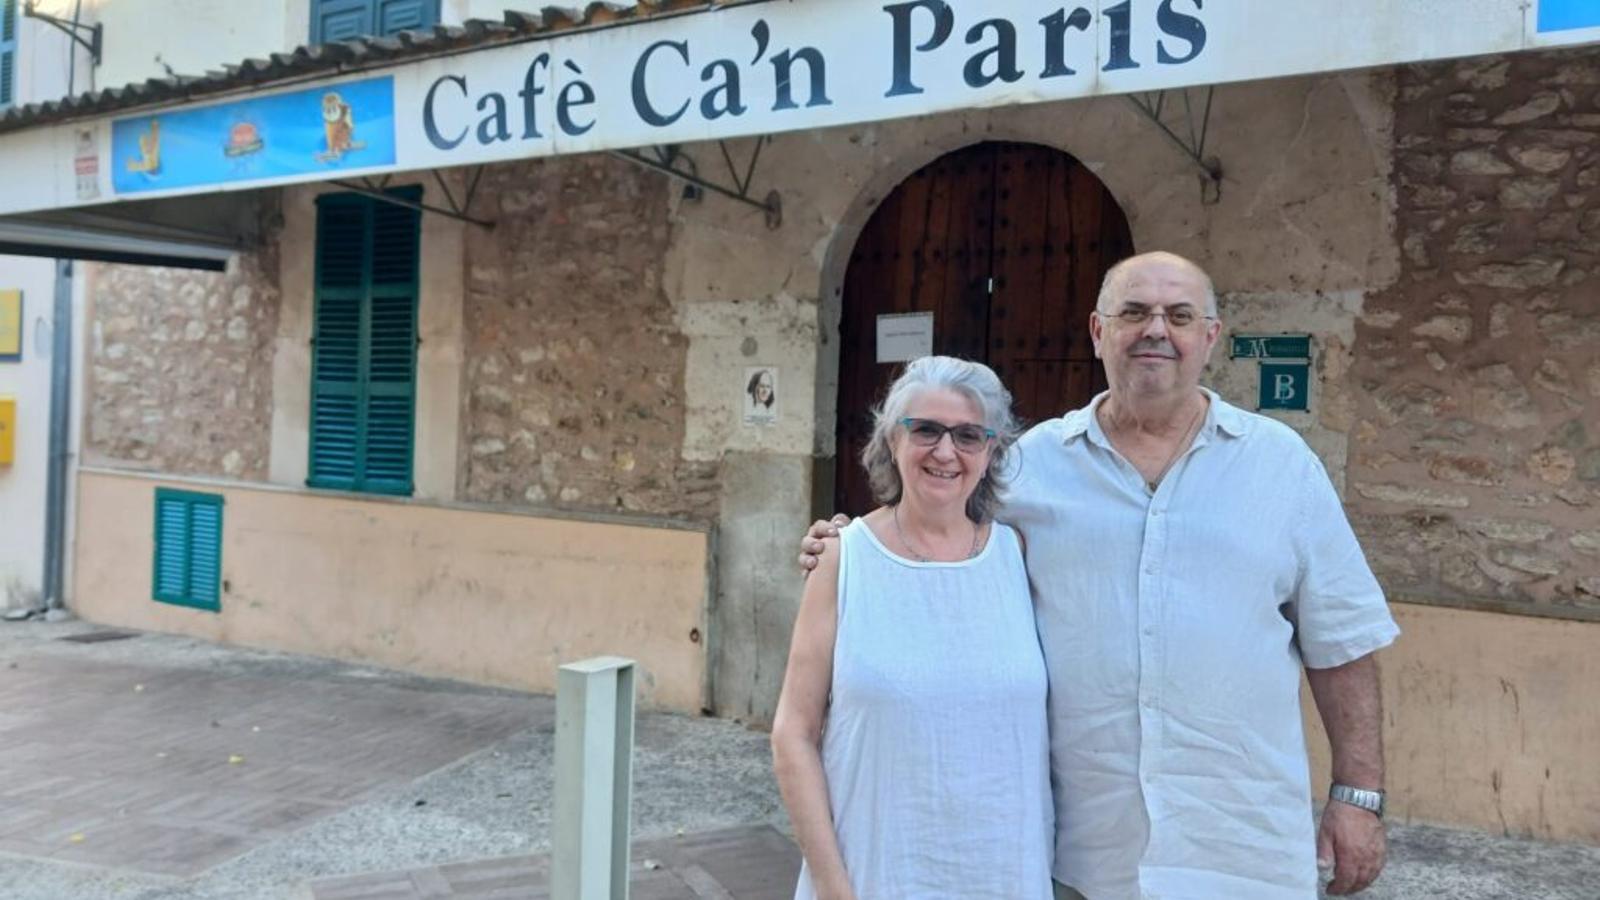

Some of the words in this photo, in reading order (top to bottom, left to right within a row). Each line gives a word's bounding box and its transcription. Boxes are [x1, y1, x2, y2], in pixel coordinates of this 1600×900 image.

[422, 53, 597, 151] Cafè
[631, 18, 832, 127] Ca'n
[883, 0, 1207, 97] Paris
[1274, 374, 1296, 400] B
